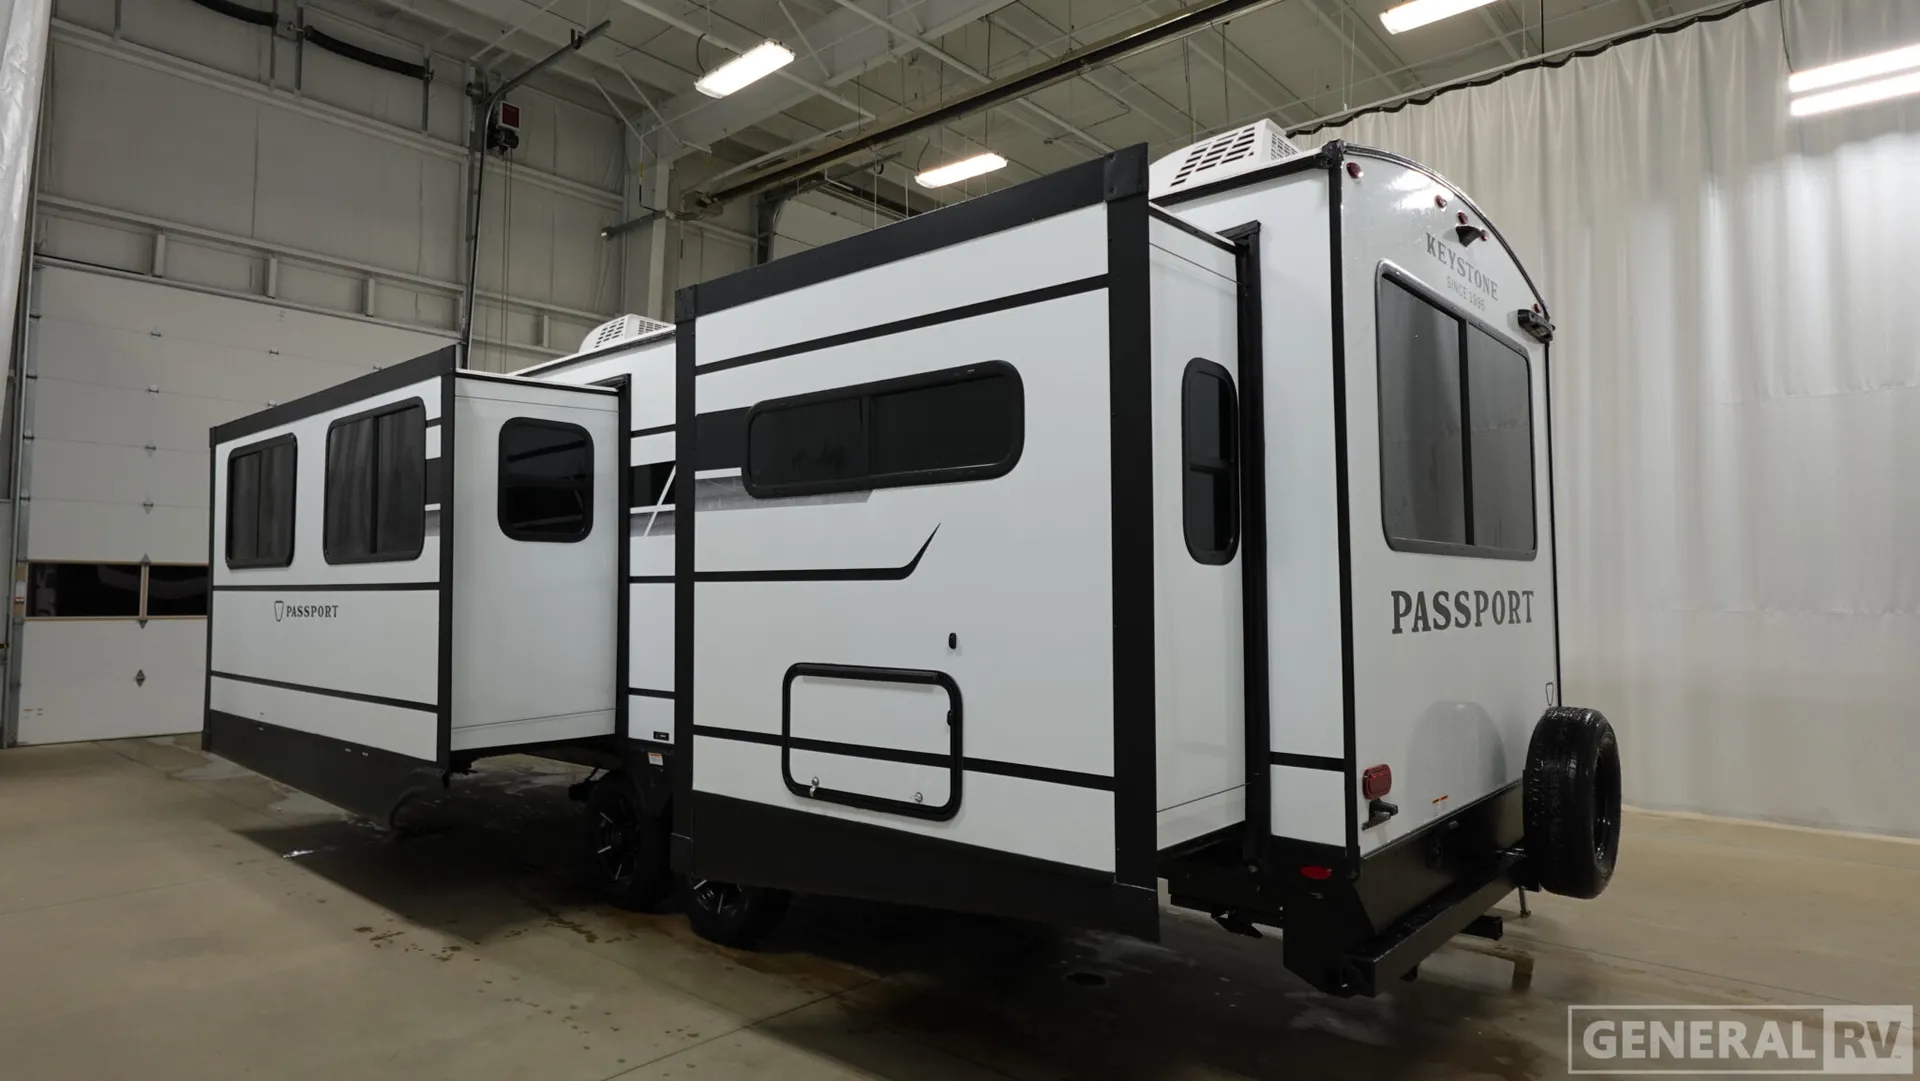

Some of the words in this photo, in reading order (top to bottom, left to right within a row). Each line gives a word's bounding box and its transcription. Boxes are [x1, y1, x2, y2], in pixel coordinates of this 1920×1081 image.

[1426, 232, 1498, 301] KEYSTONE
[1446, 275, 1467, 300] SINCE
[286, 605, 339, 618] PASSPORT
[1391, 590, 1534, 634] PASSPORT
